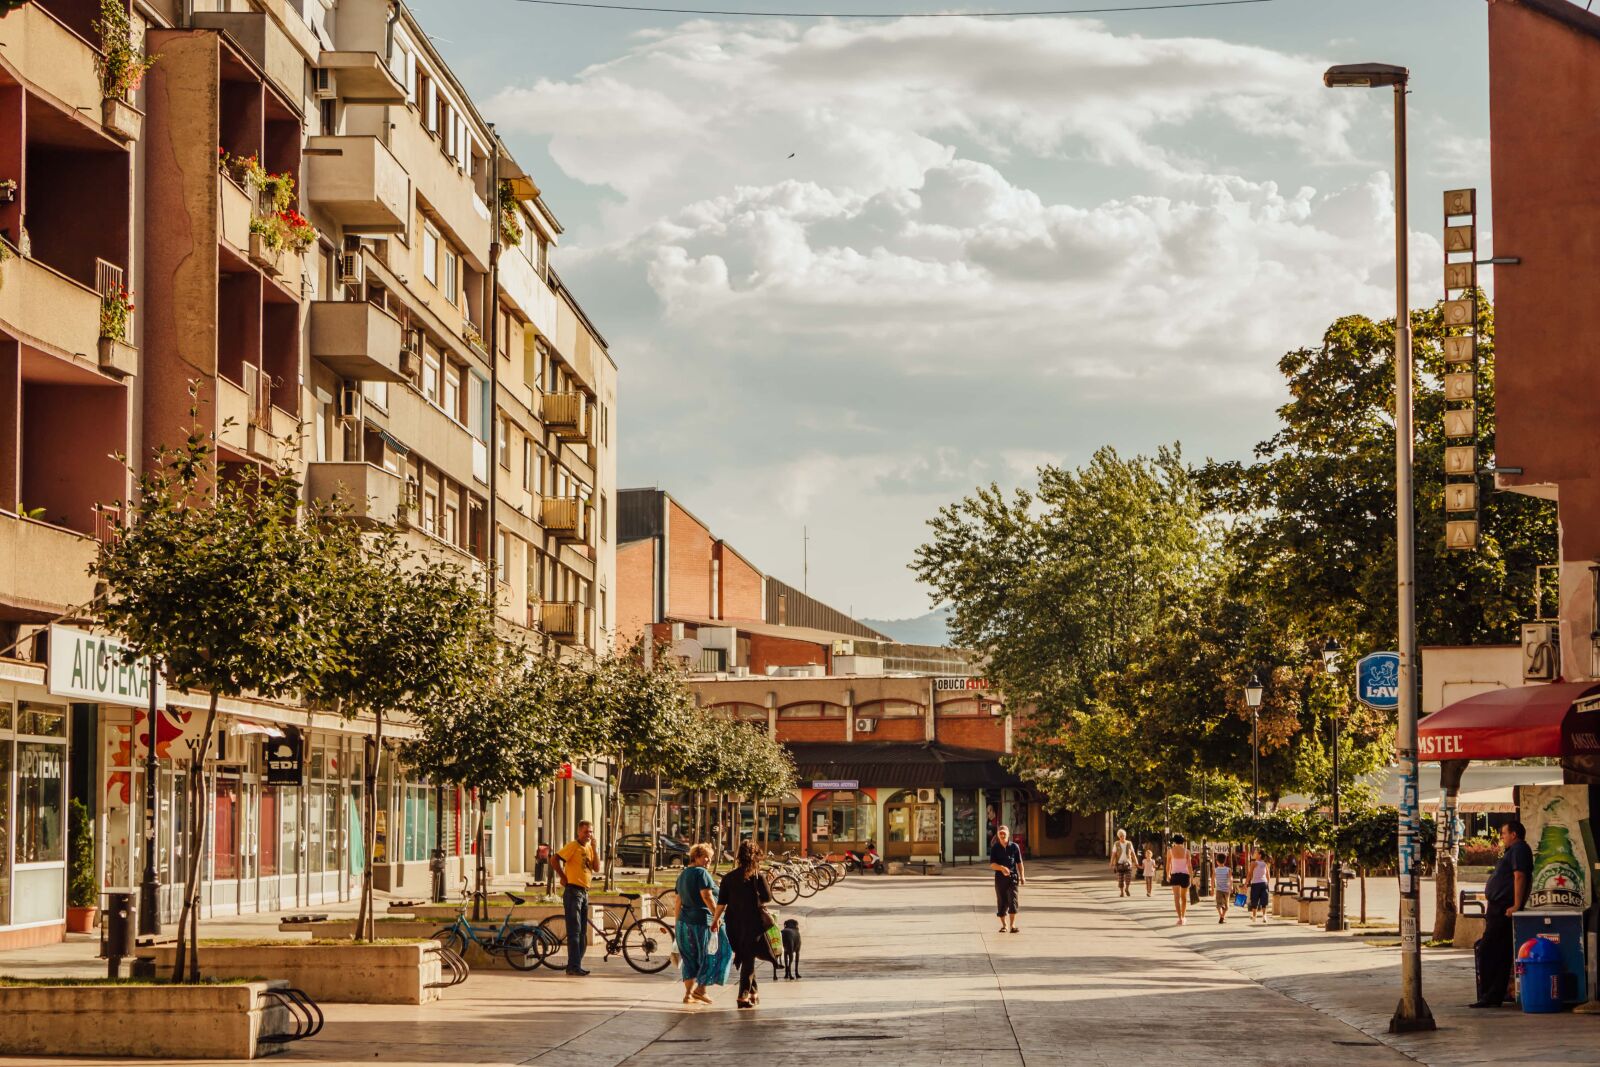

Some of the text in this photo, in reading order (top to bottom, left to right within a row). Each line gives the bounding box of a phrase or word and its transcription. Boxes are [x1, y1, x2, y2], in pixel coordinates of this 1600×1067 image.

[71, 637, 149, 699] АПОТЕКА
[1417, 735, 1463, 753] MSTEL
[20, 750, 61, 779] APOTEKA
